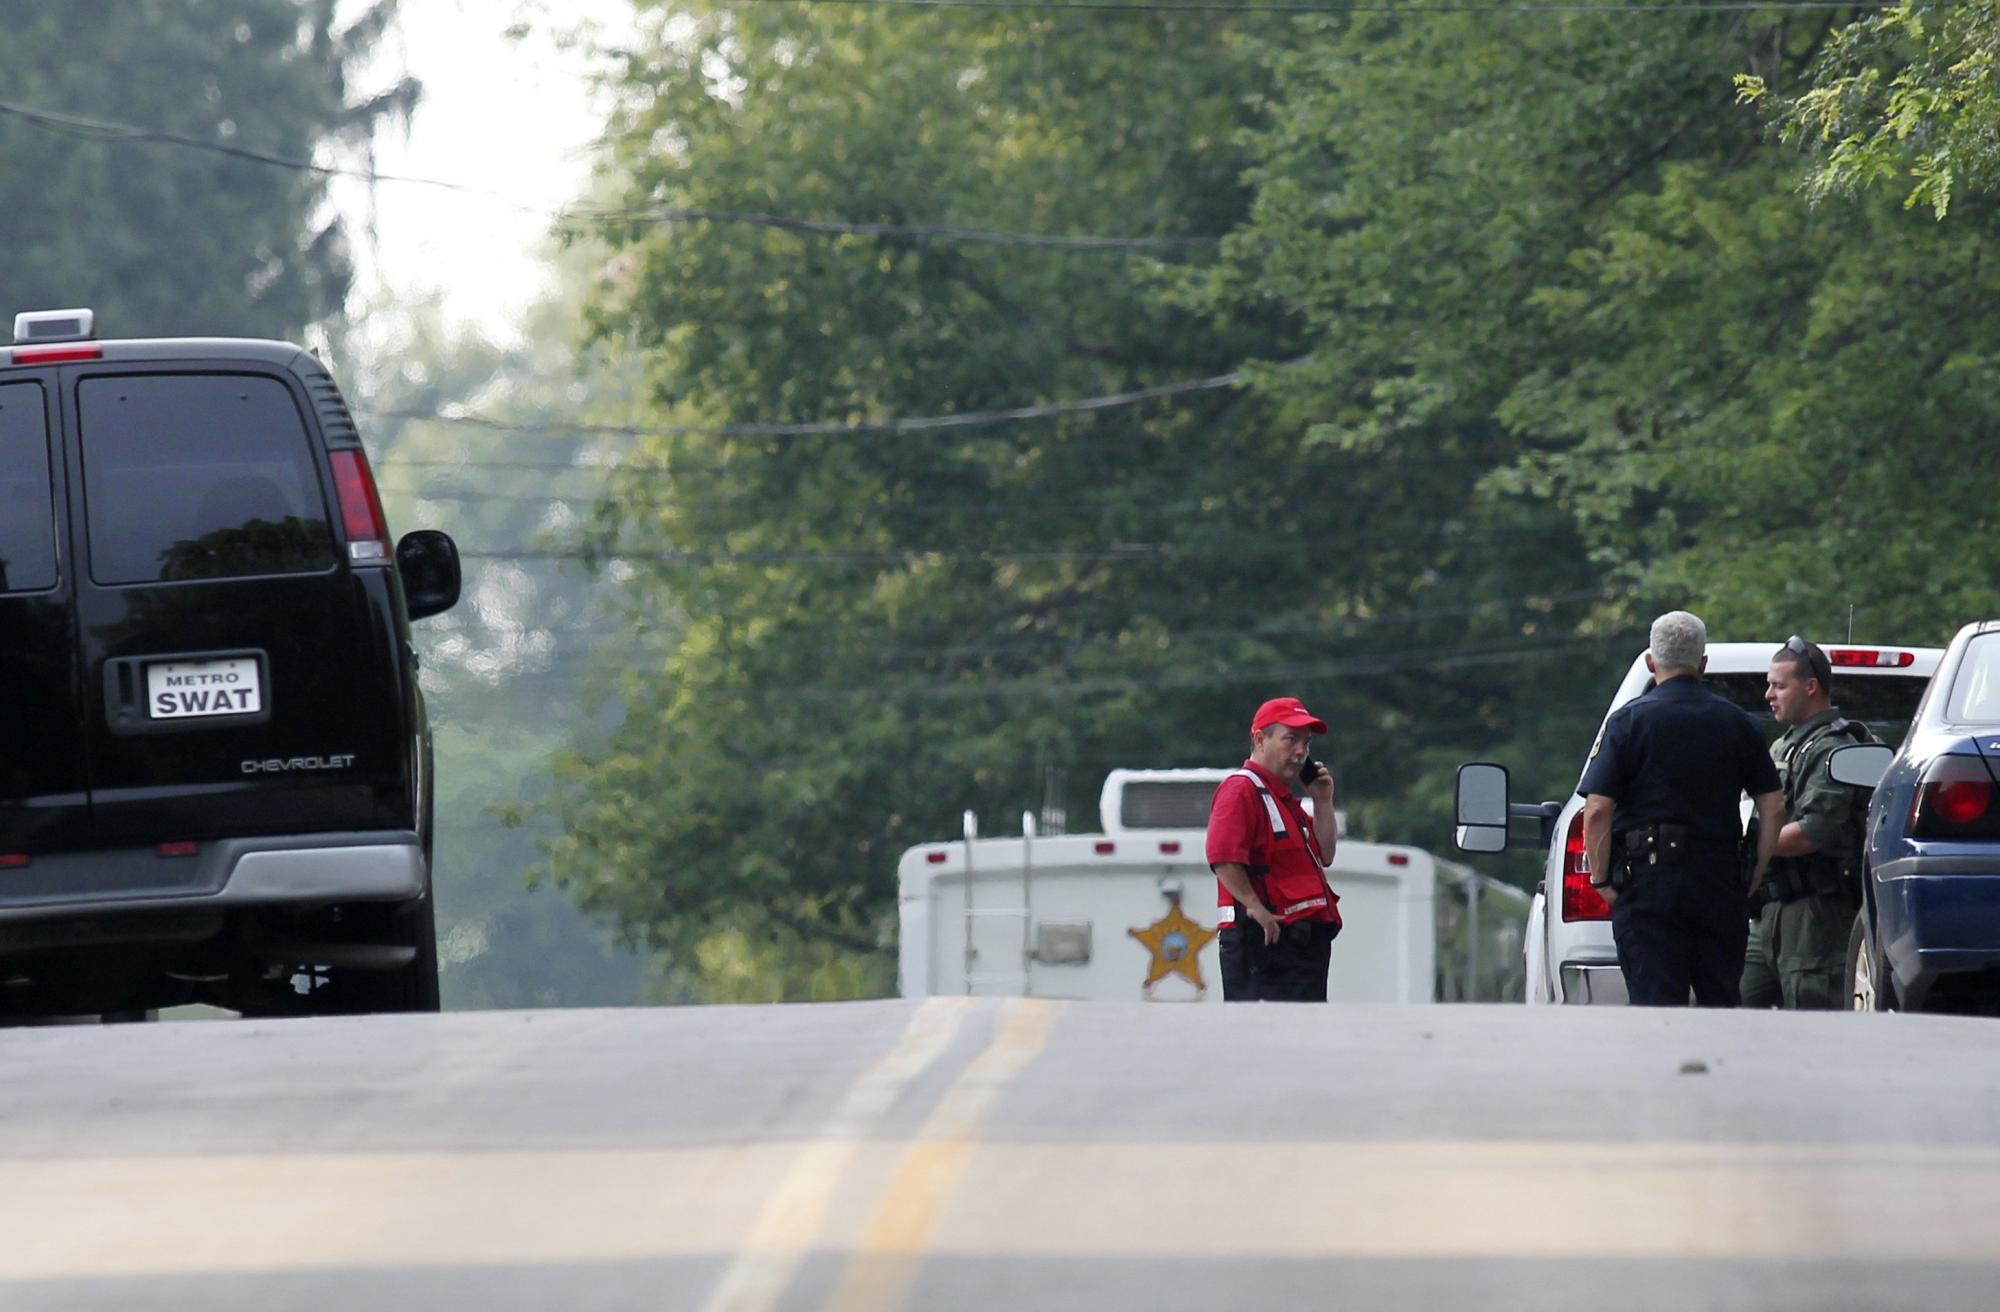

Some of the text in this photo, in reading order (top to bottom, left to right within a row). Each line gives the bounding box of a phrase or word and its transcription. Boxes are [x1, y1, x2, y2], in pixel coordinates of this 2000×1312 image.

[166, 673, 239, 687] METRO
[156, 688, 253, 714] SWAT
[241, 755, 355, 773] CHEVROLET
